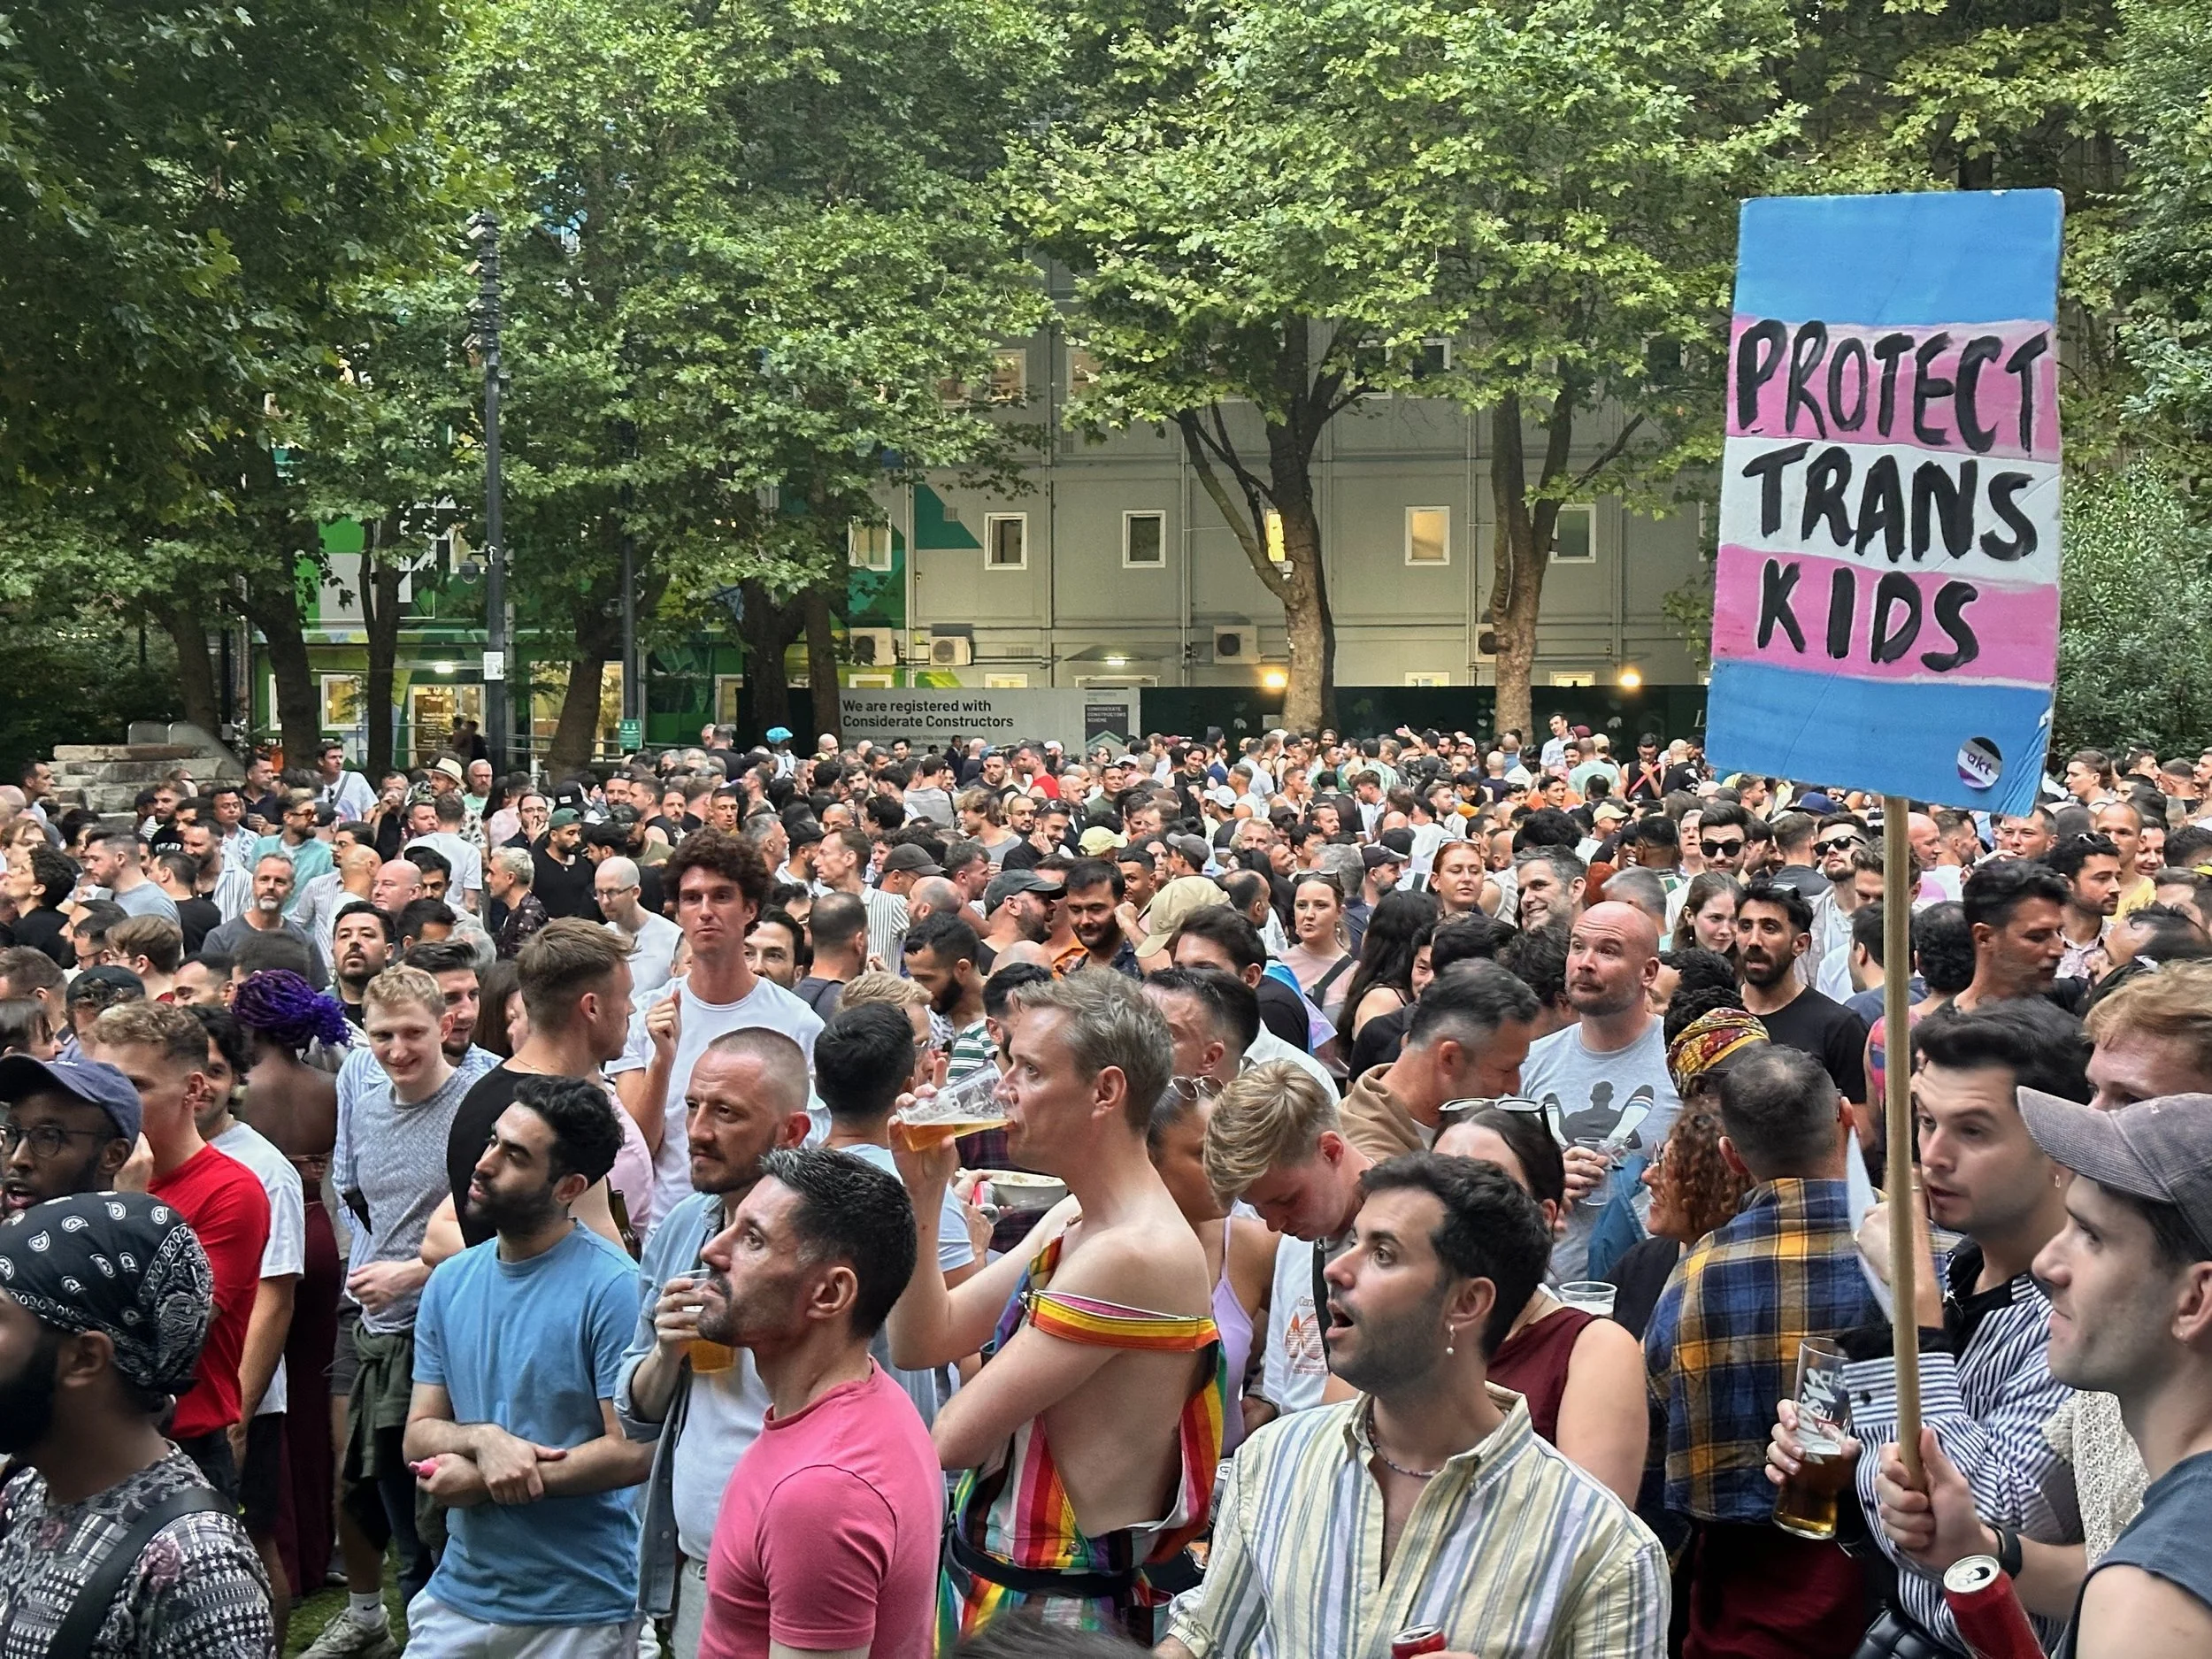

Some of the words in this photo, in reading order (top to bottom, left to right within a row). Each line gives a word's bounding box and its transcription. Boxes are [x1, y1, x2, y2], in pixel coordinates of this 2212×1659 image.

[1736, 319, 2050, 458] PROTECT
[1741, 442, 2039, 563] TRANS
[1757, 557, 1979, 672] KIDS
[842, 700, 863, 711] We
[866, 703, 887, 711] are
[890, 700, 959, 714] registered
[963, 700, 991, 711] with
[843, 715, 923, 726] Considerate
[926, 715, 1014, 726] Constructors
[1967, 753, 1992, 775] akt
